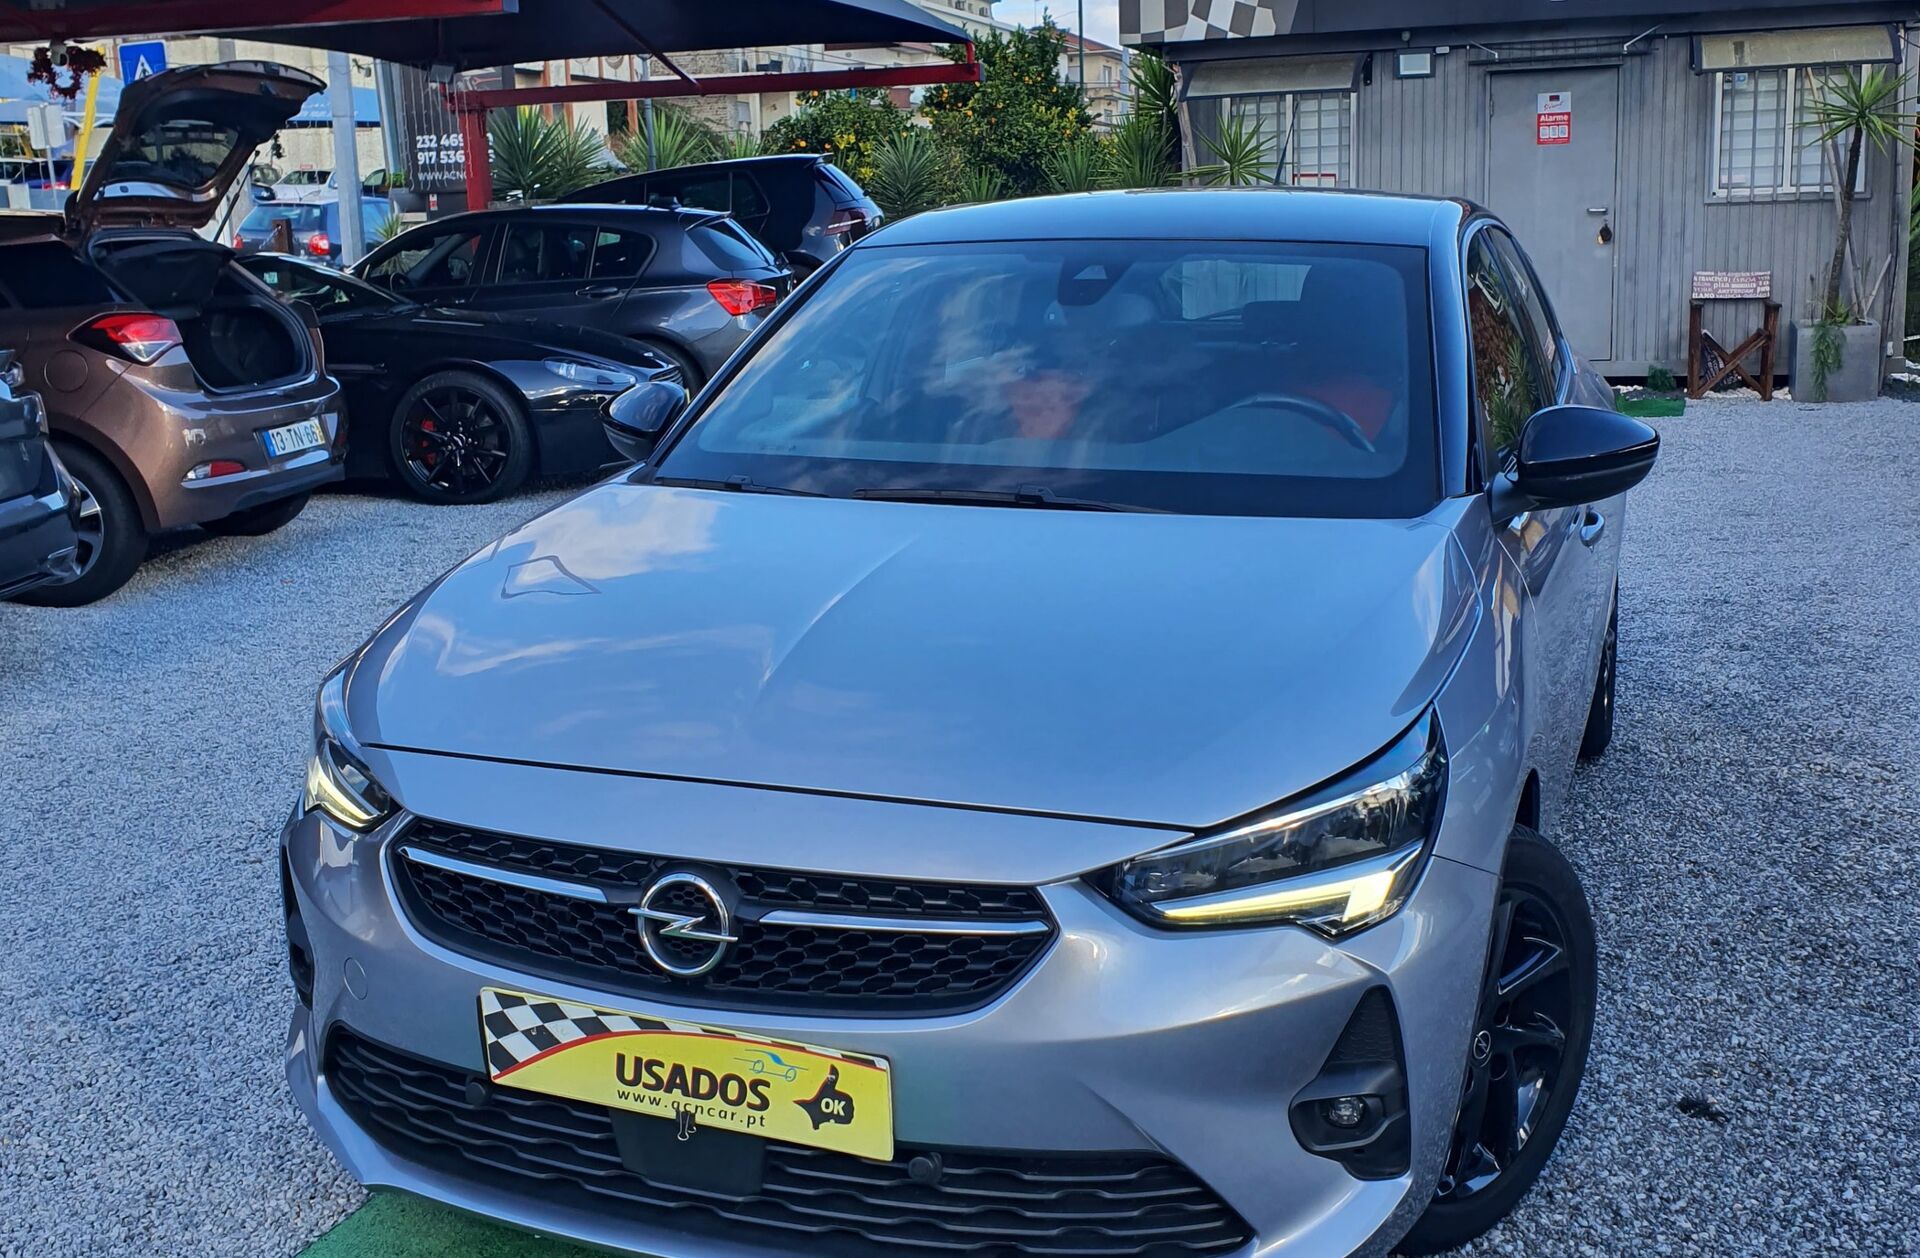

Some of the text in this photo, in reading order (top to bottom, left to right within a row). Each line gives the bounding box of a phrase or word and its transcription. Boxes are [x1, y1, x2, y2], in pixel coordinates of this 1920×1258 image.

[1540, 114, 1568, 122] Alarme
[416, 135, 437, 149] 232
[417, 150, 466, 164] 917 536
[615, 1052, 771, 1112] USADOS
[617, 1089, 766, 1128] www.acncar.pt
[820, 1097, 846, 1116] OK
